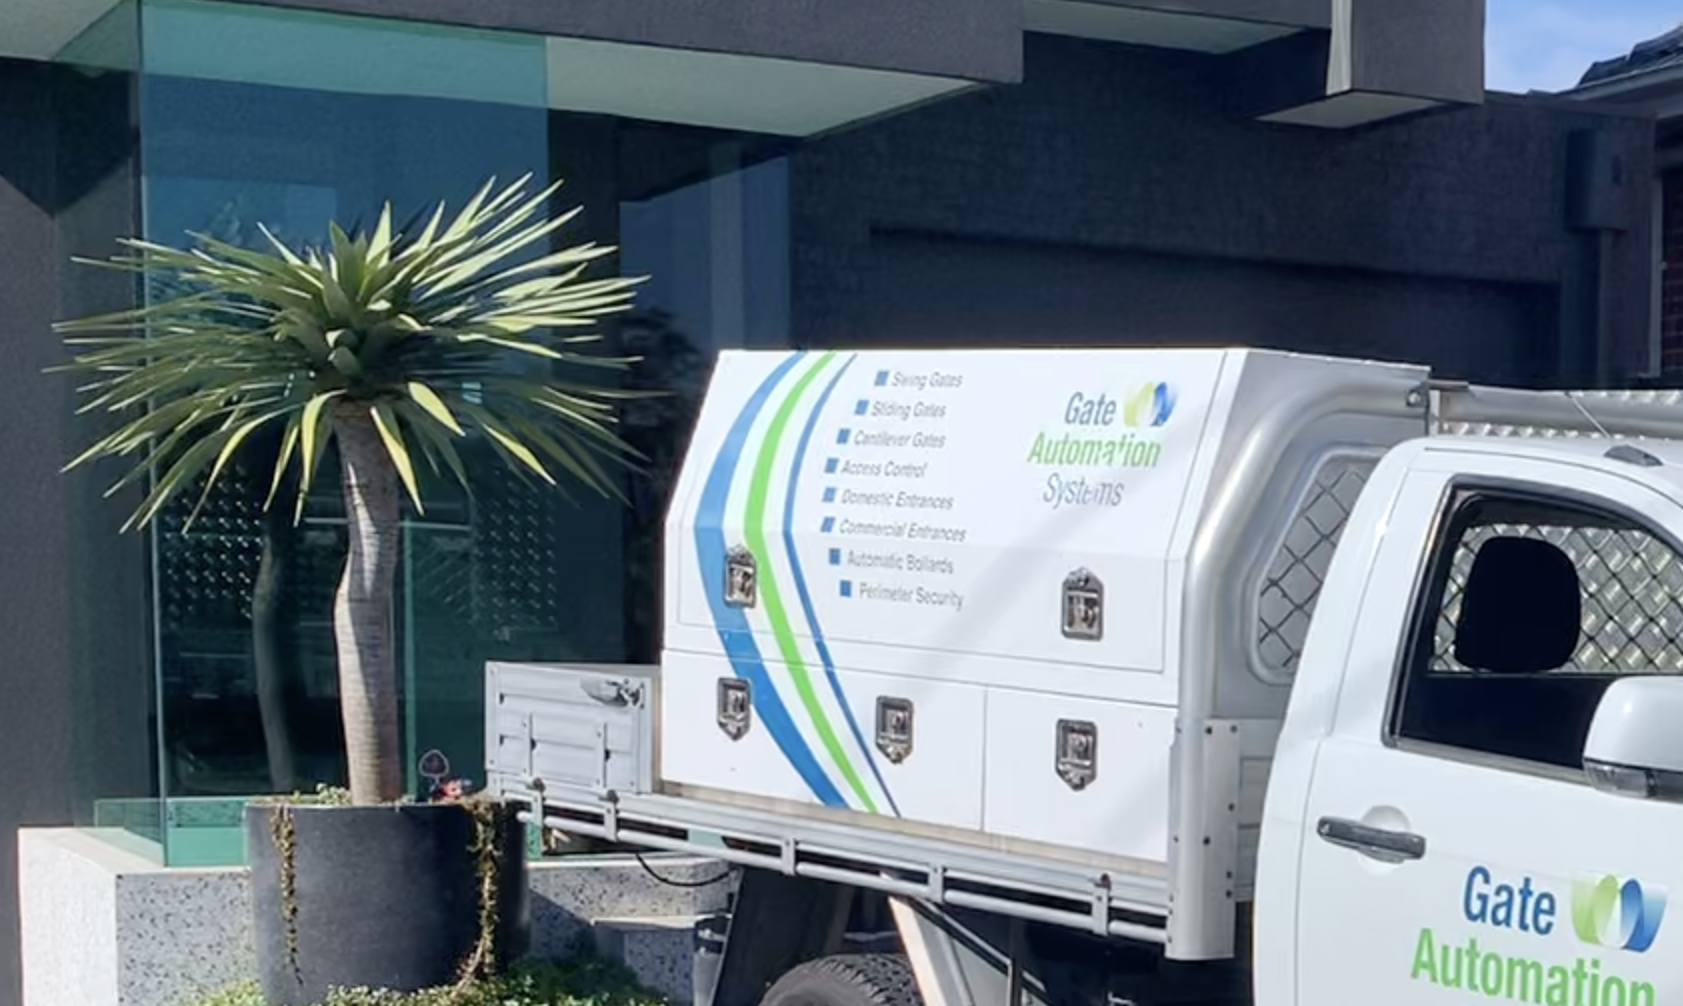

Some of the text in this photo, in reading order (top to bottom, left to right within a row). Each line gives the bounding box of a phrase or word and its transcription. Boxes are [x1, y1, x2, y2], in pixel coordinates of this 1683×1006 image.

[891, 371, 962, 390] Swing Gates
[871, 400, 946, 420] Sliding Gates
[1064, 392, 1116, 427] Gate
[853, 429, 946, 448] Cantilever Gates
[1027, 432, 1162, 468] Automation
[840, 460, 928, 478] Access Control
[841, 489, 954, 510] Domestic Entrances
[1043, 473, 1125, 509] Systems
[839, 519, 967, 542] Commercial Entrances
[847, 550, 955, 574] Automatic Bollards
[859, 581, 964, 612] Perimeter Security
[1463, 865, 1557, 935] Gate
